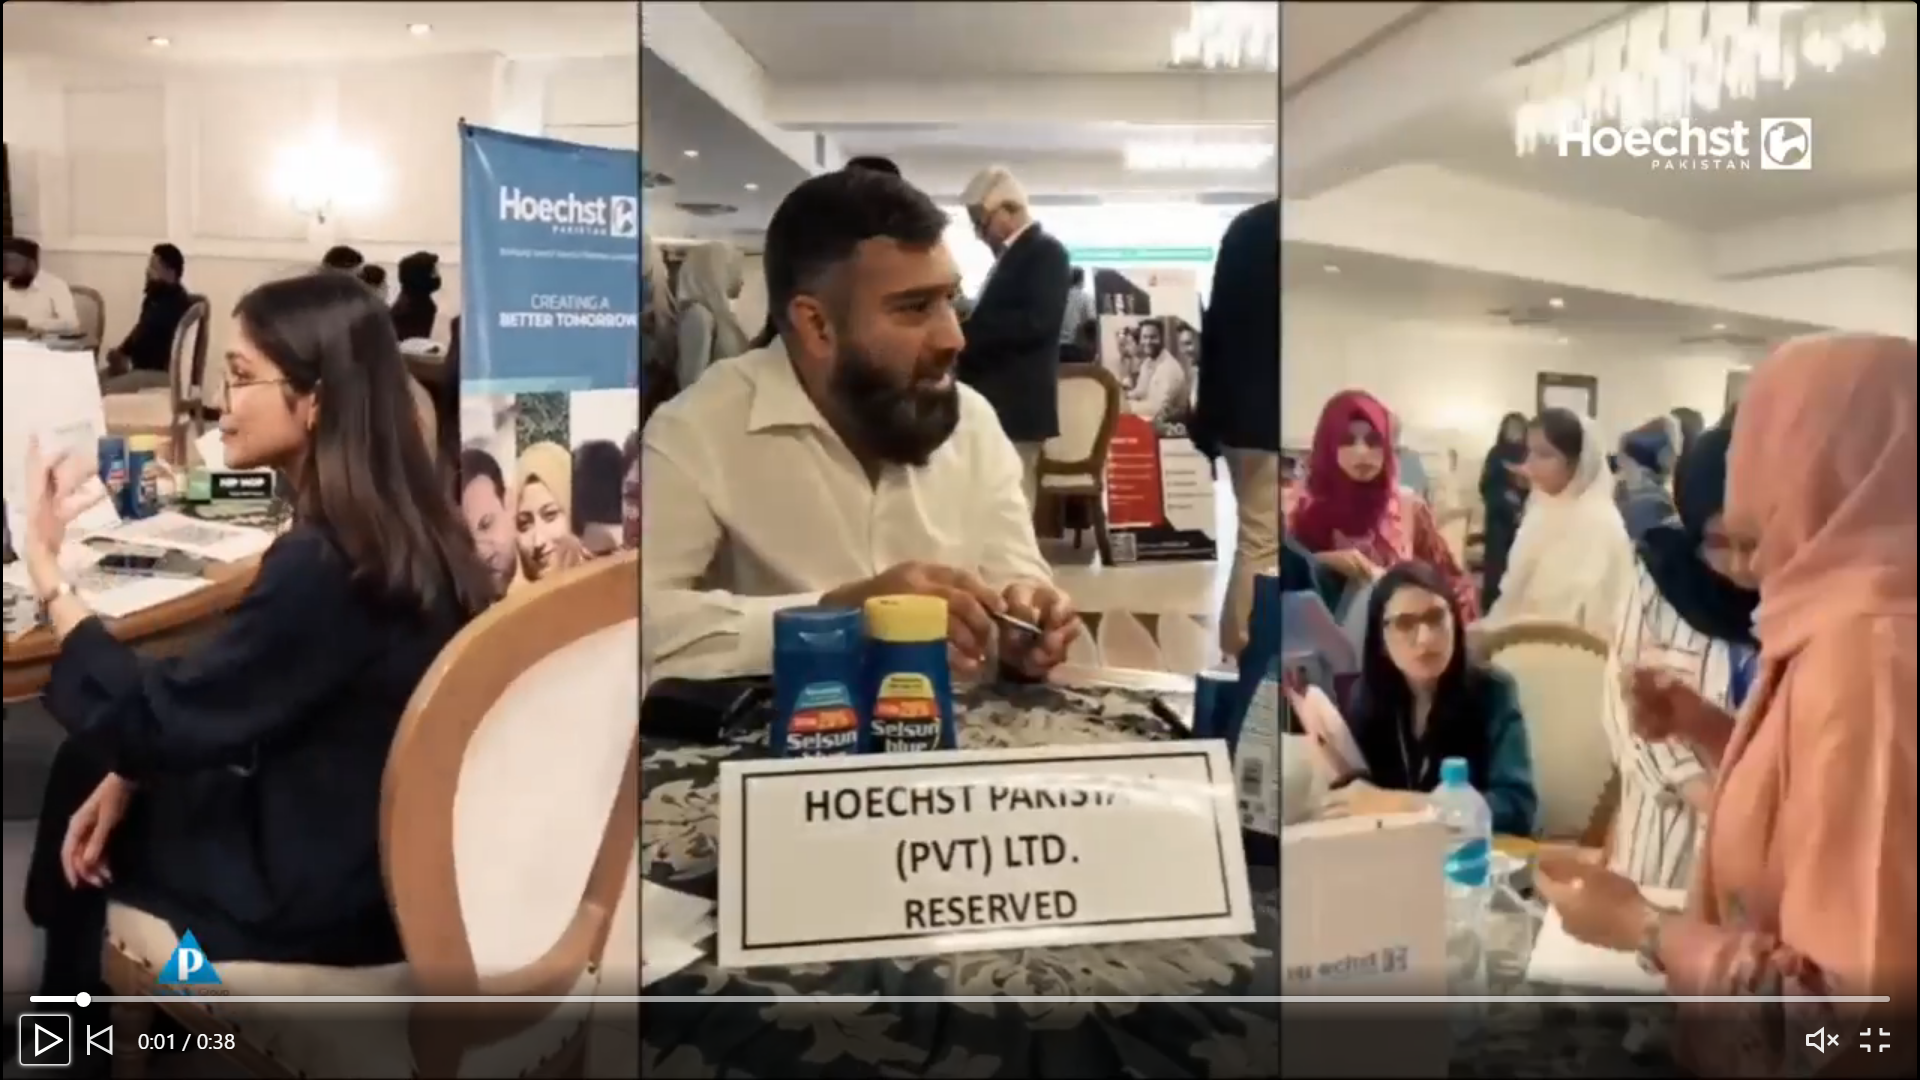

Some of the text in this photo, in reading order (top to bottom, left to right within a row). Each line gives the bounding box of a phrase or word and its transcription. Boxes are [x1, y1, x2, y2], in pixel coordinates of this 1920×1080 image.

[500, 186, 606, 225] Hoechst
[531, 294, 610, 310] CREATING A
[500, 312, 637, 329] BETTER TOMORROW
[787, 732, 858, 750] Selsun
[871, 719, 940, 738] Selsun
[805, 785, 975, 822] HOECHST
[896, 834, 1079, 882] (PVT) LTD.
[905, 890, 1077, 929] RESERVED
